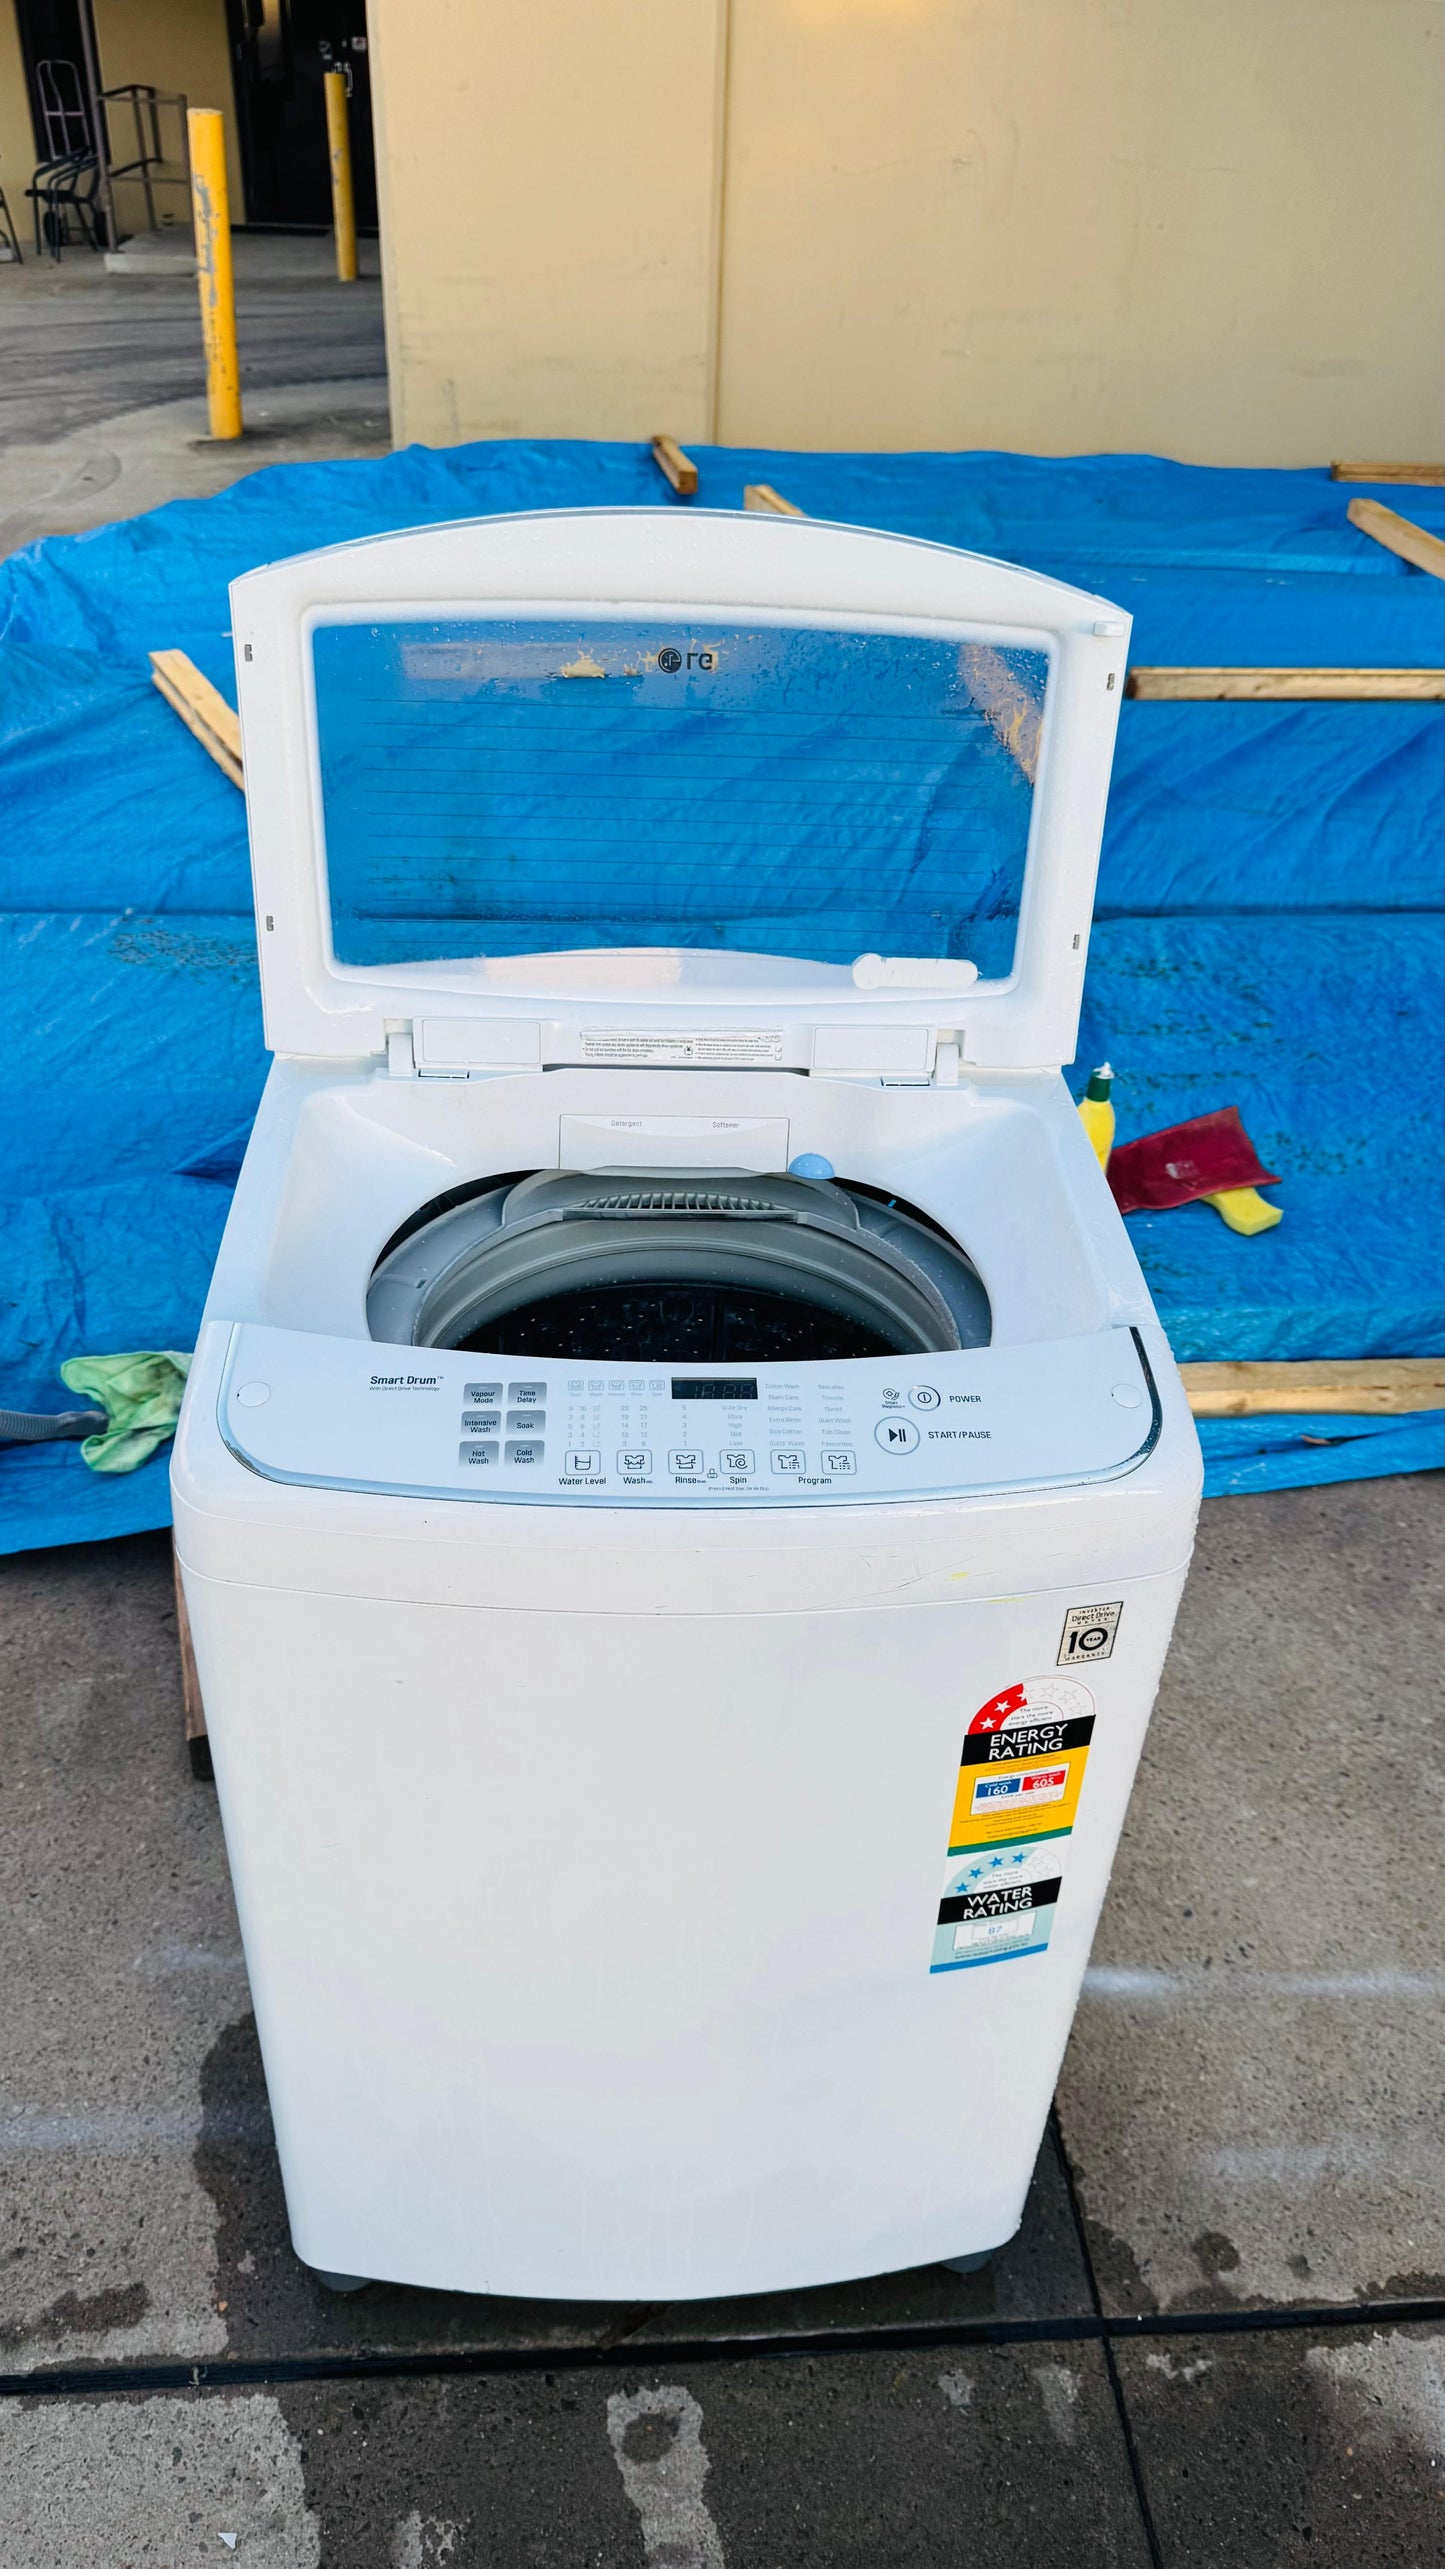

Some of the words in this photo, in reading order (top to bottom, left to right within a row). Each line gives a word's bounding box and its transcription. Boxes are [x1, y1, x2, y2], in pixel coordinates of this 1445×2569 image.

[370, 1376, 404, 1384] Smart
[928, 1431, 992, 1439] START/PAUSE
[798, 1476, 832, 1485] Program
[1069, 1628, 1108, 1654] 10
[990, 1724, 1069, 1747] ENERGY
[989, 1738, 1063, 1760] RATING
[987, 1786, 1008, 1796] 160
[1032, 1778, 1054, 1789] 605
[968, 1886, 1032, 1907] WATER
[963, 1897, 1032, 1919] RATING
